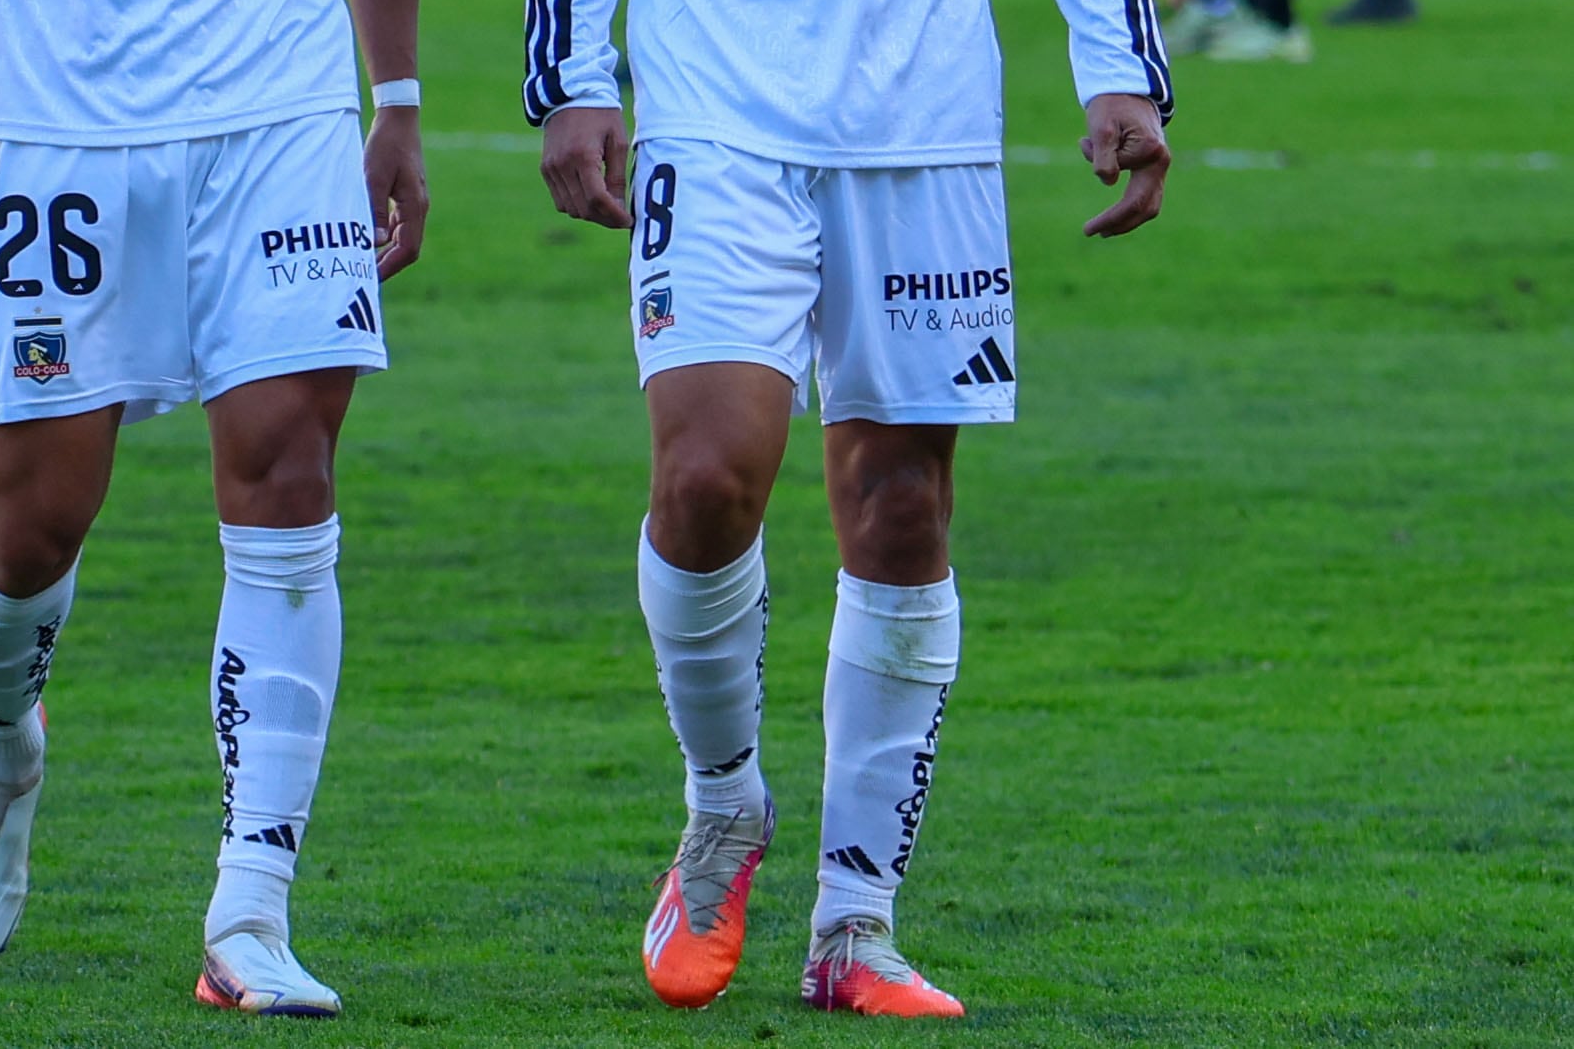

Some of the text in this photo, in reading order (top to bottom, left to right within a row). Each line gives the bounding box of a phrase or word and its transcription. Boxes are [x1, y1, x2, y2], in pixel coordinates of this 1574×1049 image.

[641, 162, 677, 262] 8
[260, 220, 373, 259] PHILIPS
[267, 262, 298, 287] TV
[306, 258, 325, 281] &
[883, 267, 1011, 301] PHILIPS
[884, 303, 1014, 331] TV & Audio
[16, 365, 67, 377] COLO-COLO
